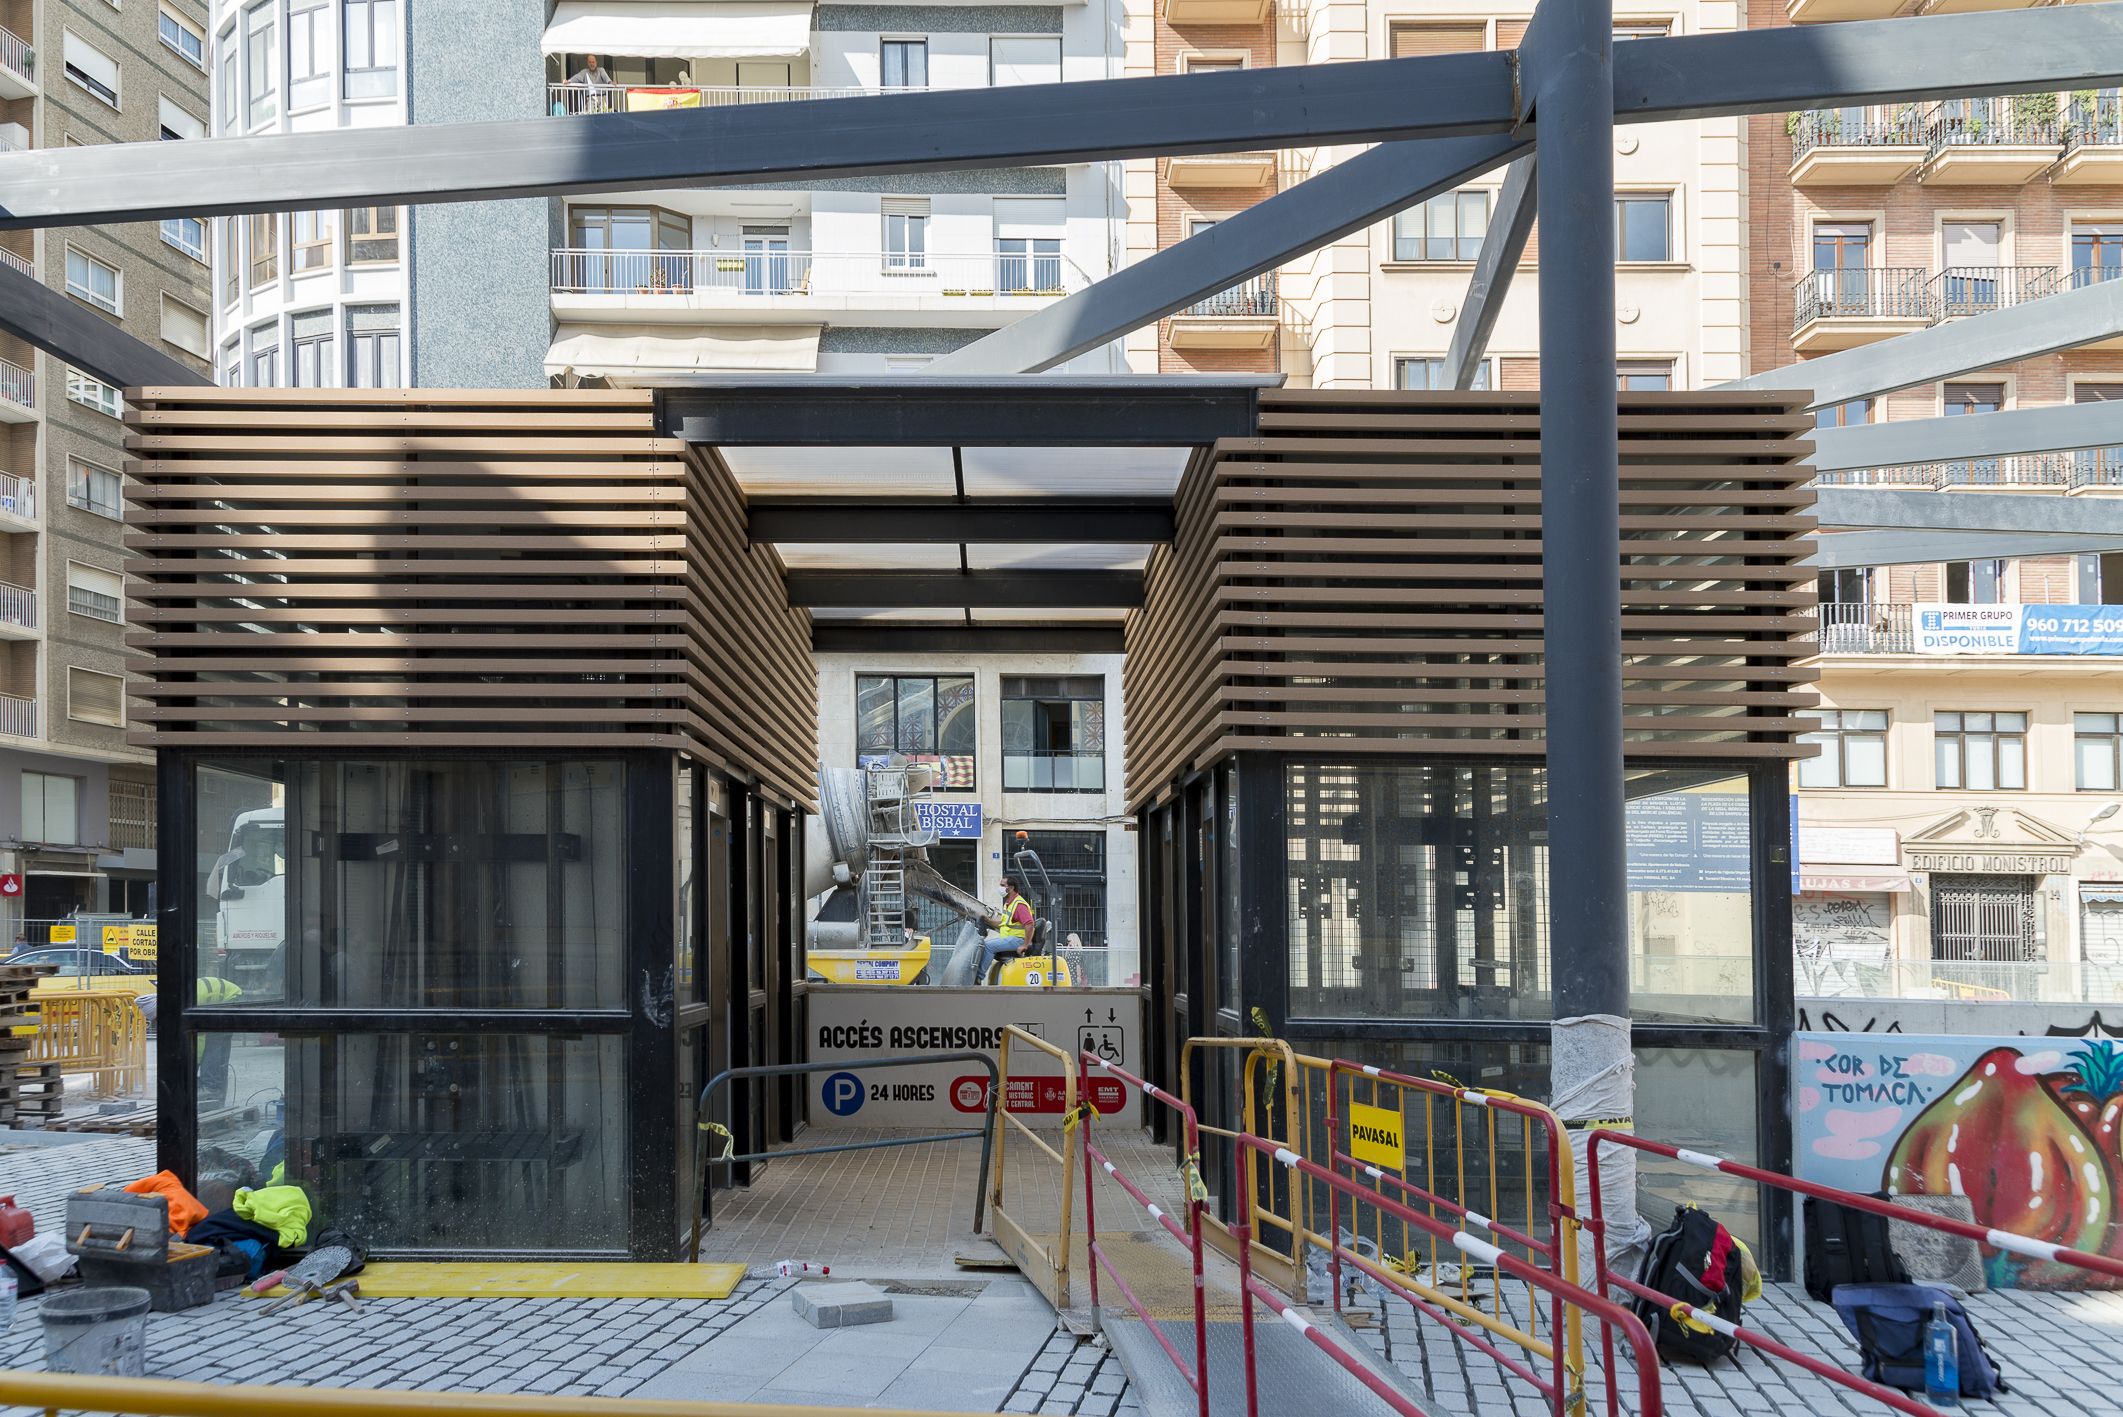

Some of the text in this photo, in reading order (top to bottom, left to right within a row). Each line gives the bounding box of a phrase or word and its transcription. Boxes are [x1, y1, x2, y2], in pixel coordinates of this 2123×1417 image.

[1943, 611, 2013, 620] PRIMER GRUPO
[2026, 618, 2123, 632] 960 712 509
[1924, 636, 2014, 647] DISPONIBLE
[917, 804, 978, 817] HOSTAL
[922, 816, 973, 829] BISBAL
[1912, 855, 2068, 872] EDIFICIO MONISTROL
[1029, 973, 1039, 984] 20
[819, 1018, 883, 1049] ACCÉS
[1879, 1055, 1910, 1079] DE
[835, 1079, 857, 1110] P
[871, 1084, 935, 1101] 24 HORES
[1352, 1124, 1399, 1149] PAVASAL
